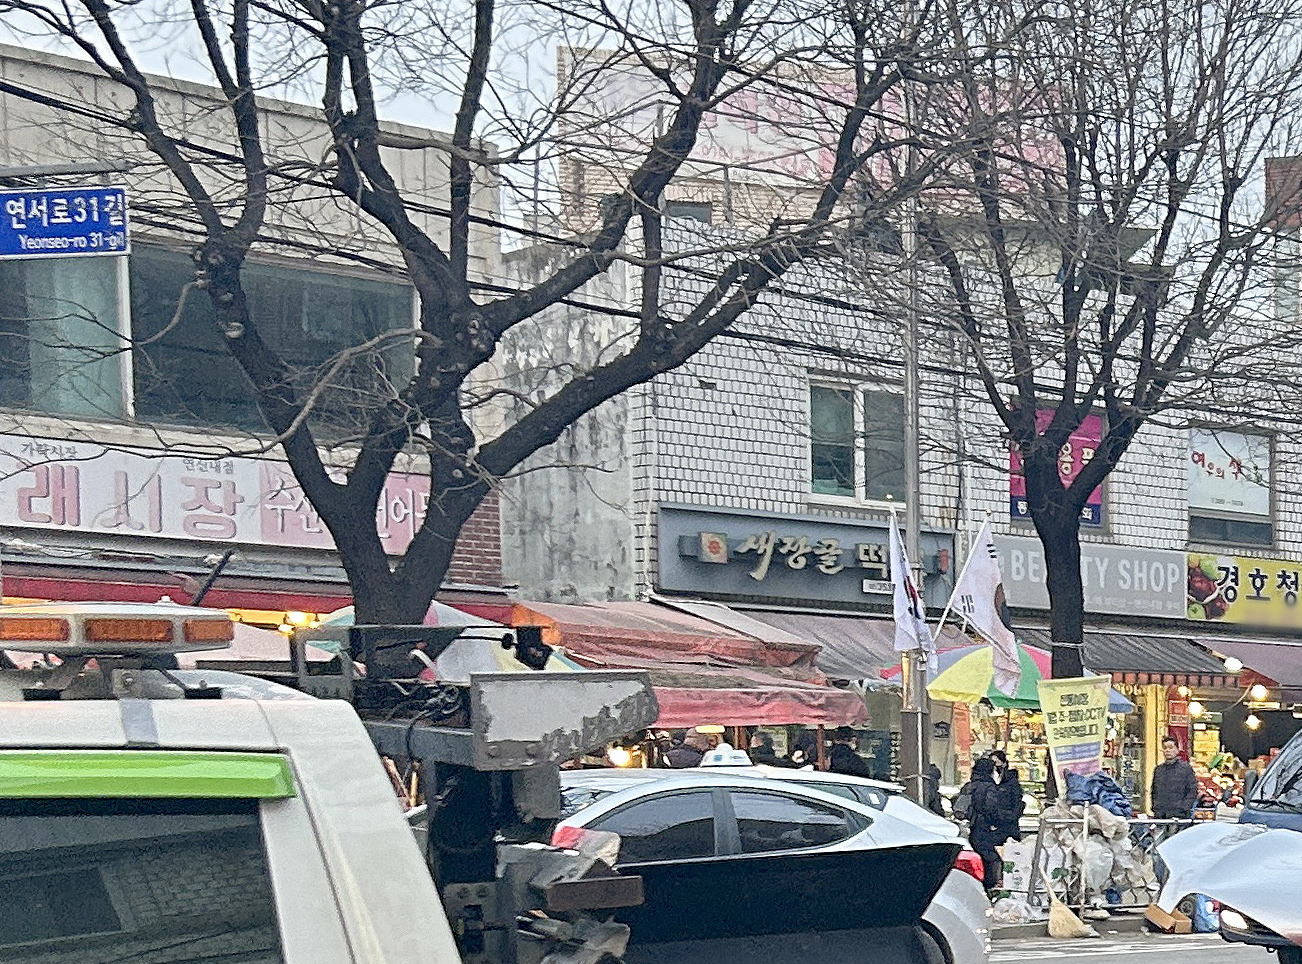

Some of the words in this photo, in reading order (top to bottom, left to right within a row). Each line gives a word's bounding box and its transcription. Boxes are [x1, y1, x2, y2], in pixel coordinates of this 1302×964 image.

[5, 193, 124, 229] 연서로31길
[18, 233, 87, 250] Yeonseo-ro
[89, 231, 125, 250] 31-gil
[1117, 558, 1181, 594] SHOP
